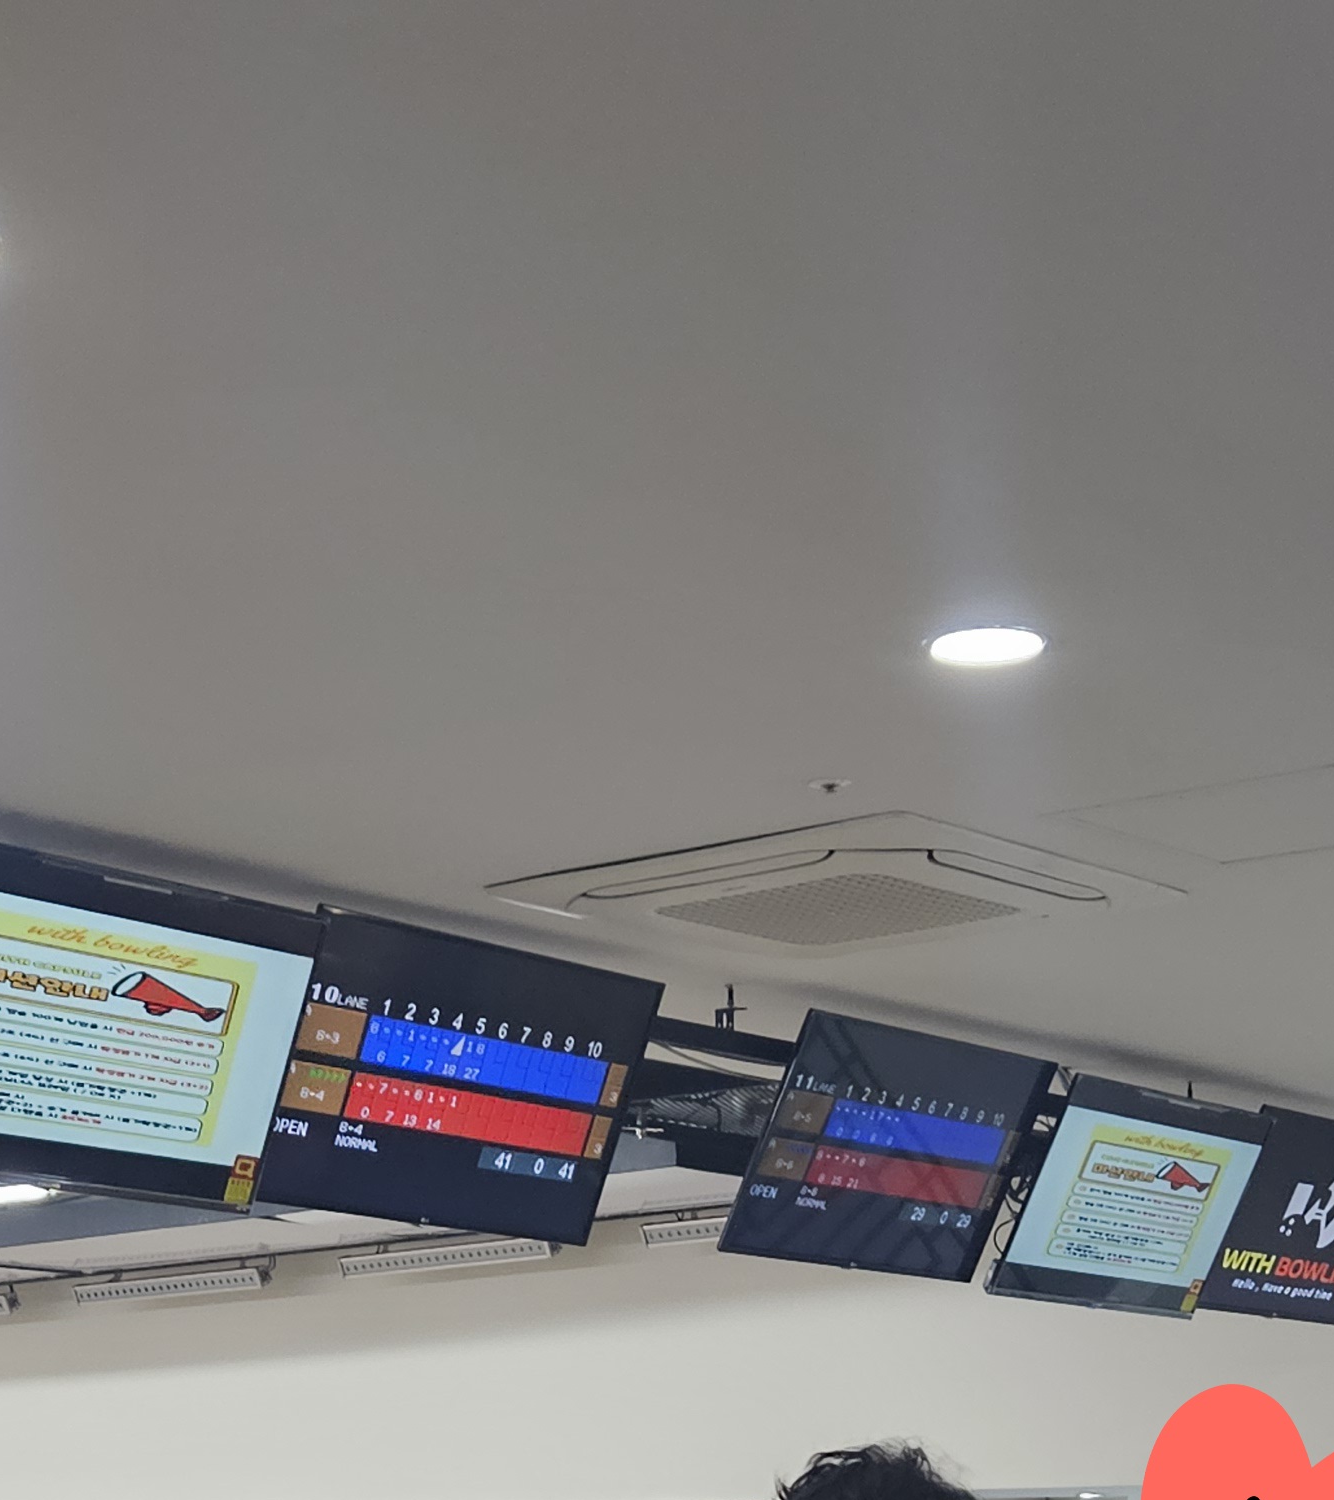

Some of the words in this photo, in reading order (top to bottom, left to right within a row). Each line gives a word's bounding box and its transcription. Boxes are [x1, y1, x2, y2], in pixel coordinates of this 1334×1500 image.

[28, 924, 86, 944] with
[93, 934, 197, 968] bowling
[384, 999, 391, 1016] 1
[405, 1003, 416, 1021] 2
[429, 1008, 440, 1025] 3
[453, 1013, 463, 1030] 4
[475, 1018, 487, 1034] 5
[499, 1022, 509, 1039] 6
[521, 1027, 532, 1043] 7
[542, 1031, 552, 1048] 8
[564, 1036, 575, 1052] 9
[588, 1040, 603, 1058] 10
[464, 1067, 480, 1080] 27
[451, 1096, 457, 1108] 1
[847, 1085, 853, 1098] 1
[862, 1087, 871, 1101] 2
[878, 1091, 886, 1104] 3
[896, 1094, 904, 1107] 4
[911, 1097, 921, 1111] 5
[928, 1101, 937, 1114] 6
[945, 1103, 953, 1117] 7
[960, 1107, 968, 1120] 8
[976, 1110, 984, 1123] 9
[993, 1113, 1004, 1126] 10
[386, 1110, 394, 1122] 7
[426, 1118, 441, 1131] 14
[335, 1134, 377, 1152] NORMAL
[495, 1152, 512, 1170] 41
[534, 1158, 544, 1174] 0
[559, 1163, 575, 1180] 41
[750, 1184, 778, 1199] OPEN
[911, 1207, 925, 1221] 29
[940, 1211, 948, 1224] 0
[956, 1213, 971, 1227] 29
[1222, 1248, 1276, 1274] WITH
[1290, 1287, 1315, 1297] good
